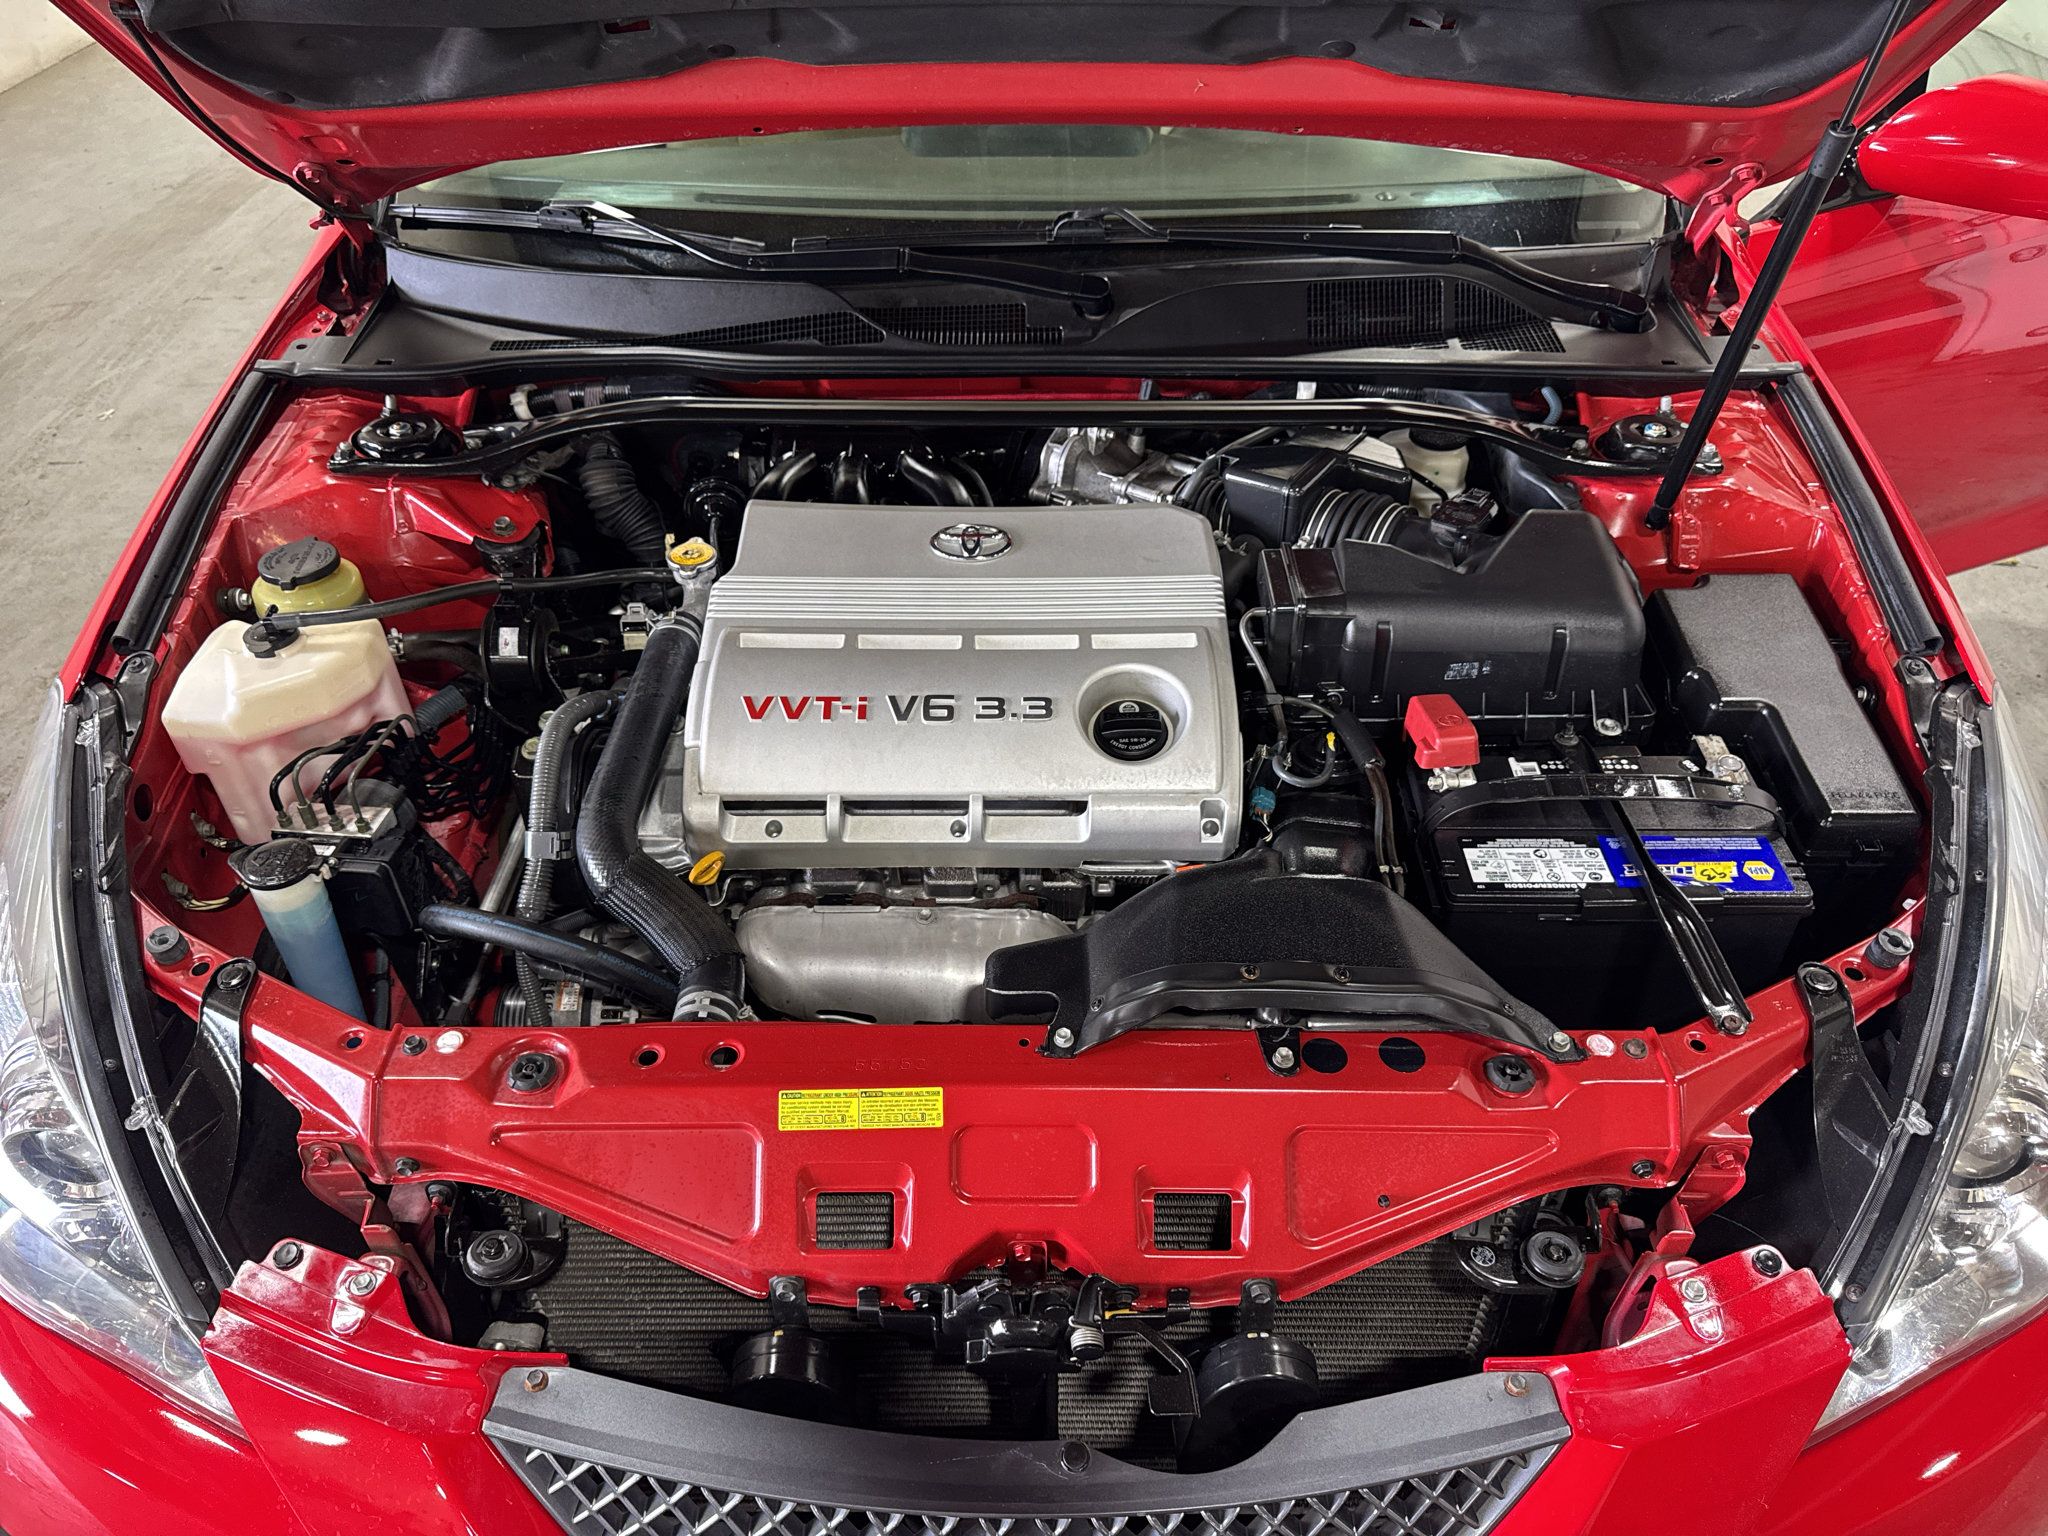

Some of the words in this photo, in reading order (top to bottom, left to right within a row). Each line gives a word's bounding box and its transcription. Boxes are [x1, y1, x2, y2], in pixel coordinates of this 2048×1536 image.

[742, 695, 868, 722] VVT-i
[886, 694, 955, 722] V6
[974, 695, 1053, 722] 3.3
[1750, 866, 1770, 875] NAPA
